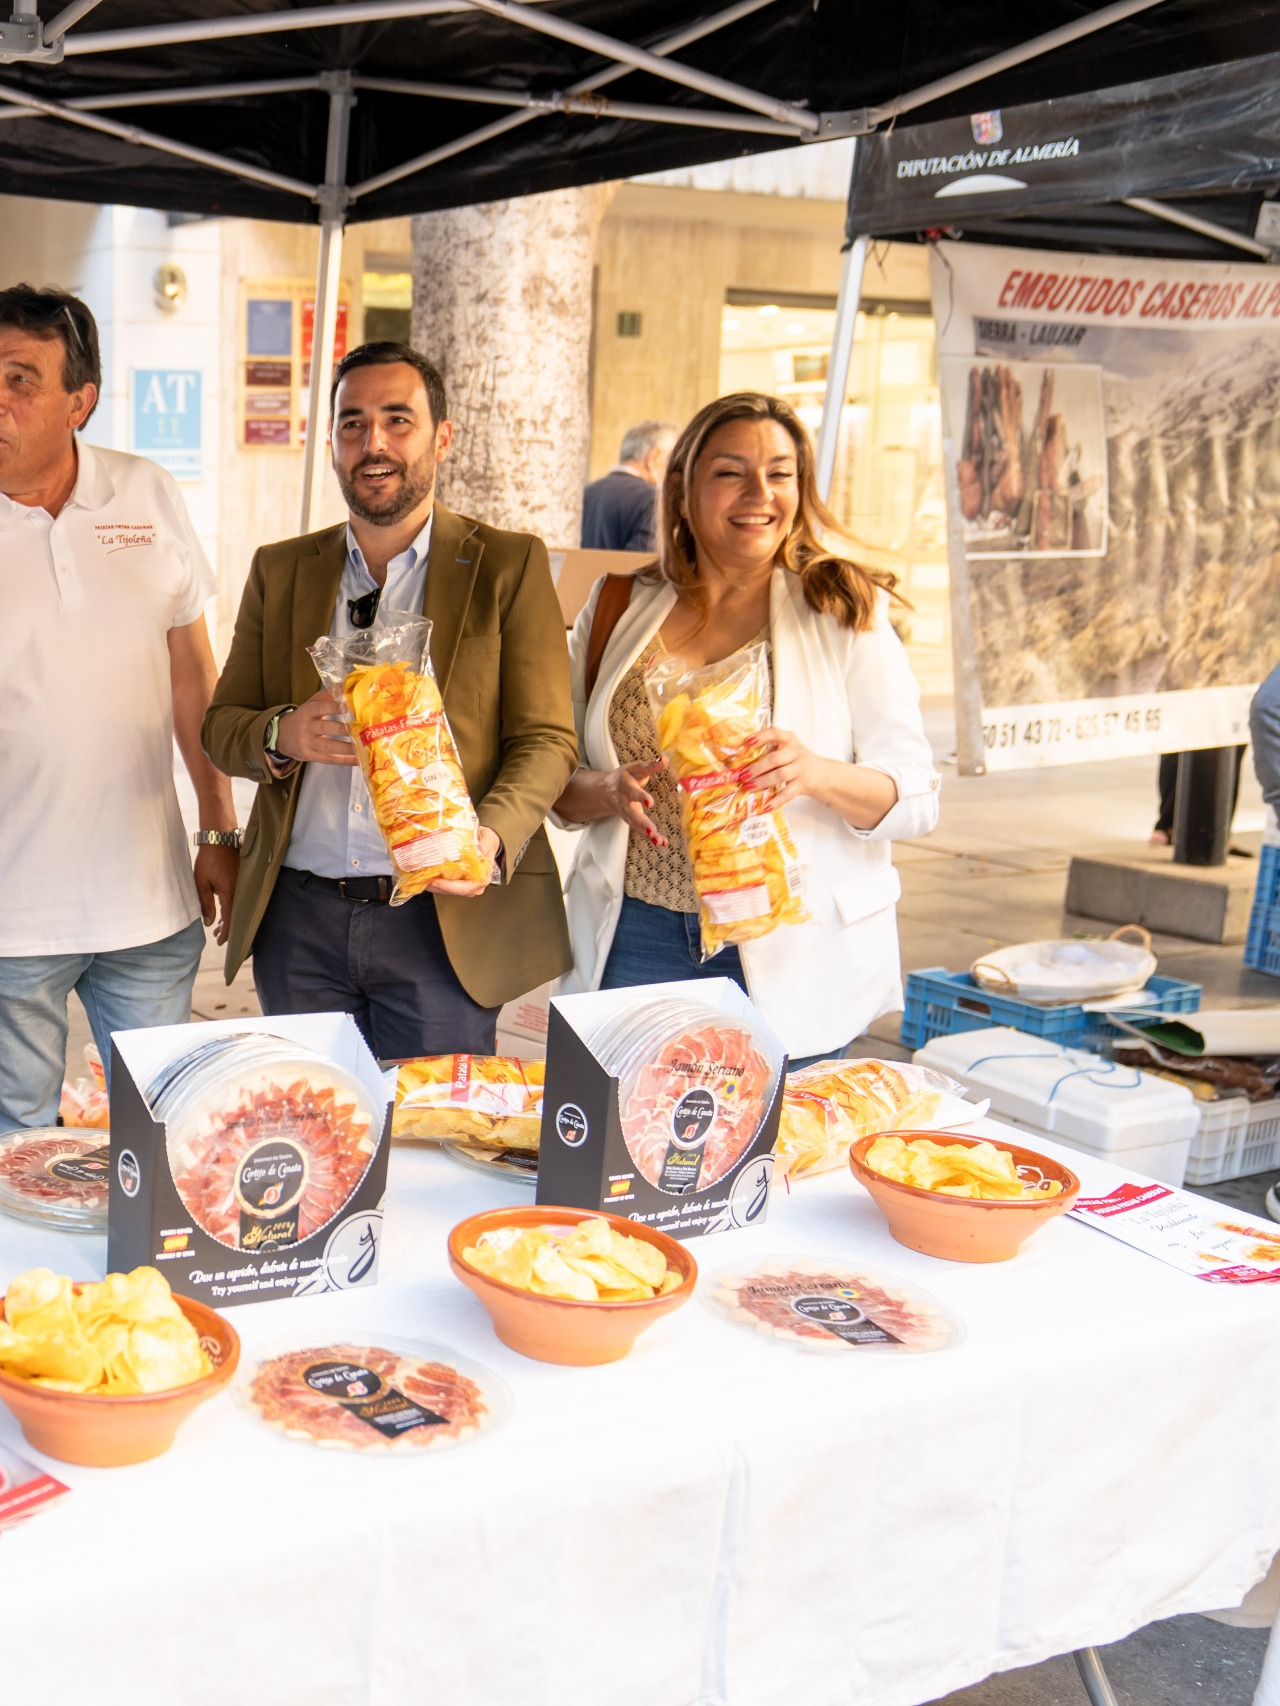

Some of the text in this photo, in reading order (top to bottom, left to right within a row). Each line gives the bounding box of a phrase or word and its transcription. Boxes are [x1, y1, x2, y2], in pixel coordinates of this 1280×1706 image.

[897, 136, 1080, 178] DIPUTACIÓN DE ALMERÍA
[998, 270, 1144, 319] EMBUTIDOS
[1140, 279, 1245, 320] CASEROS
[1029, 323, 1087, 347] LAUJAR
[142, 374, 196, 414] AT
[365, 723, 398, 741] Patatas
[1000, 723, 1017, 747] 51
[1024, 720, 1043, 745] 43
[423, 775, 437, 784] SIN
[455, 1062, 468, 1089] Patatas
[667, 1059, 745, 1077] Jamón Serrano
[242, 1162, 302, 1184] Cortijo de Canata
[215, 1271, 226, 1281] un
[227, 1264, 259, 1282] capricho,
[260, 1260, 288, 1275] disfrute
[289, 1258, 299, 1271] de
[211, 1286, 226, 1297] Try
[226, 1280, 259, 1296] yourself
[259, 1278, 274, 1289] and
[275, 1276, 296, 1289] enjoy
